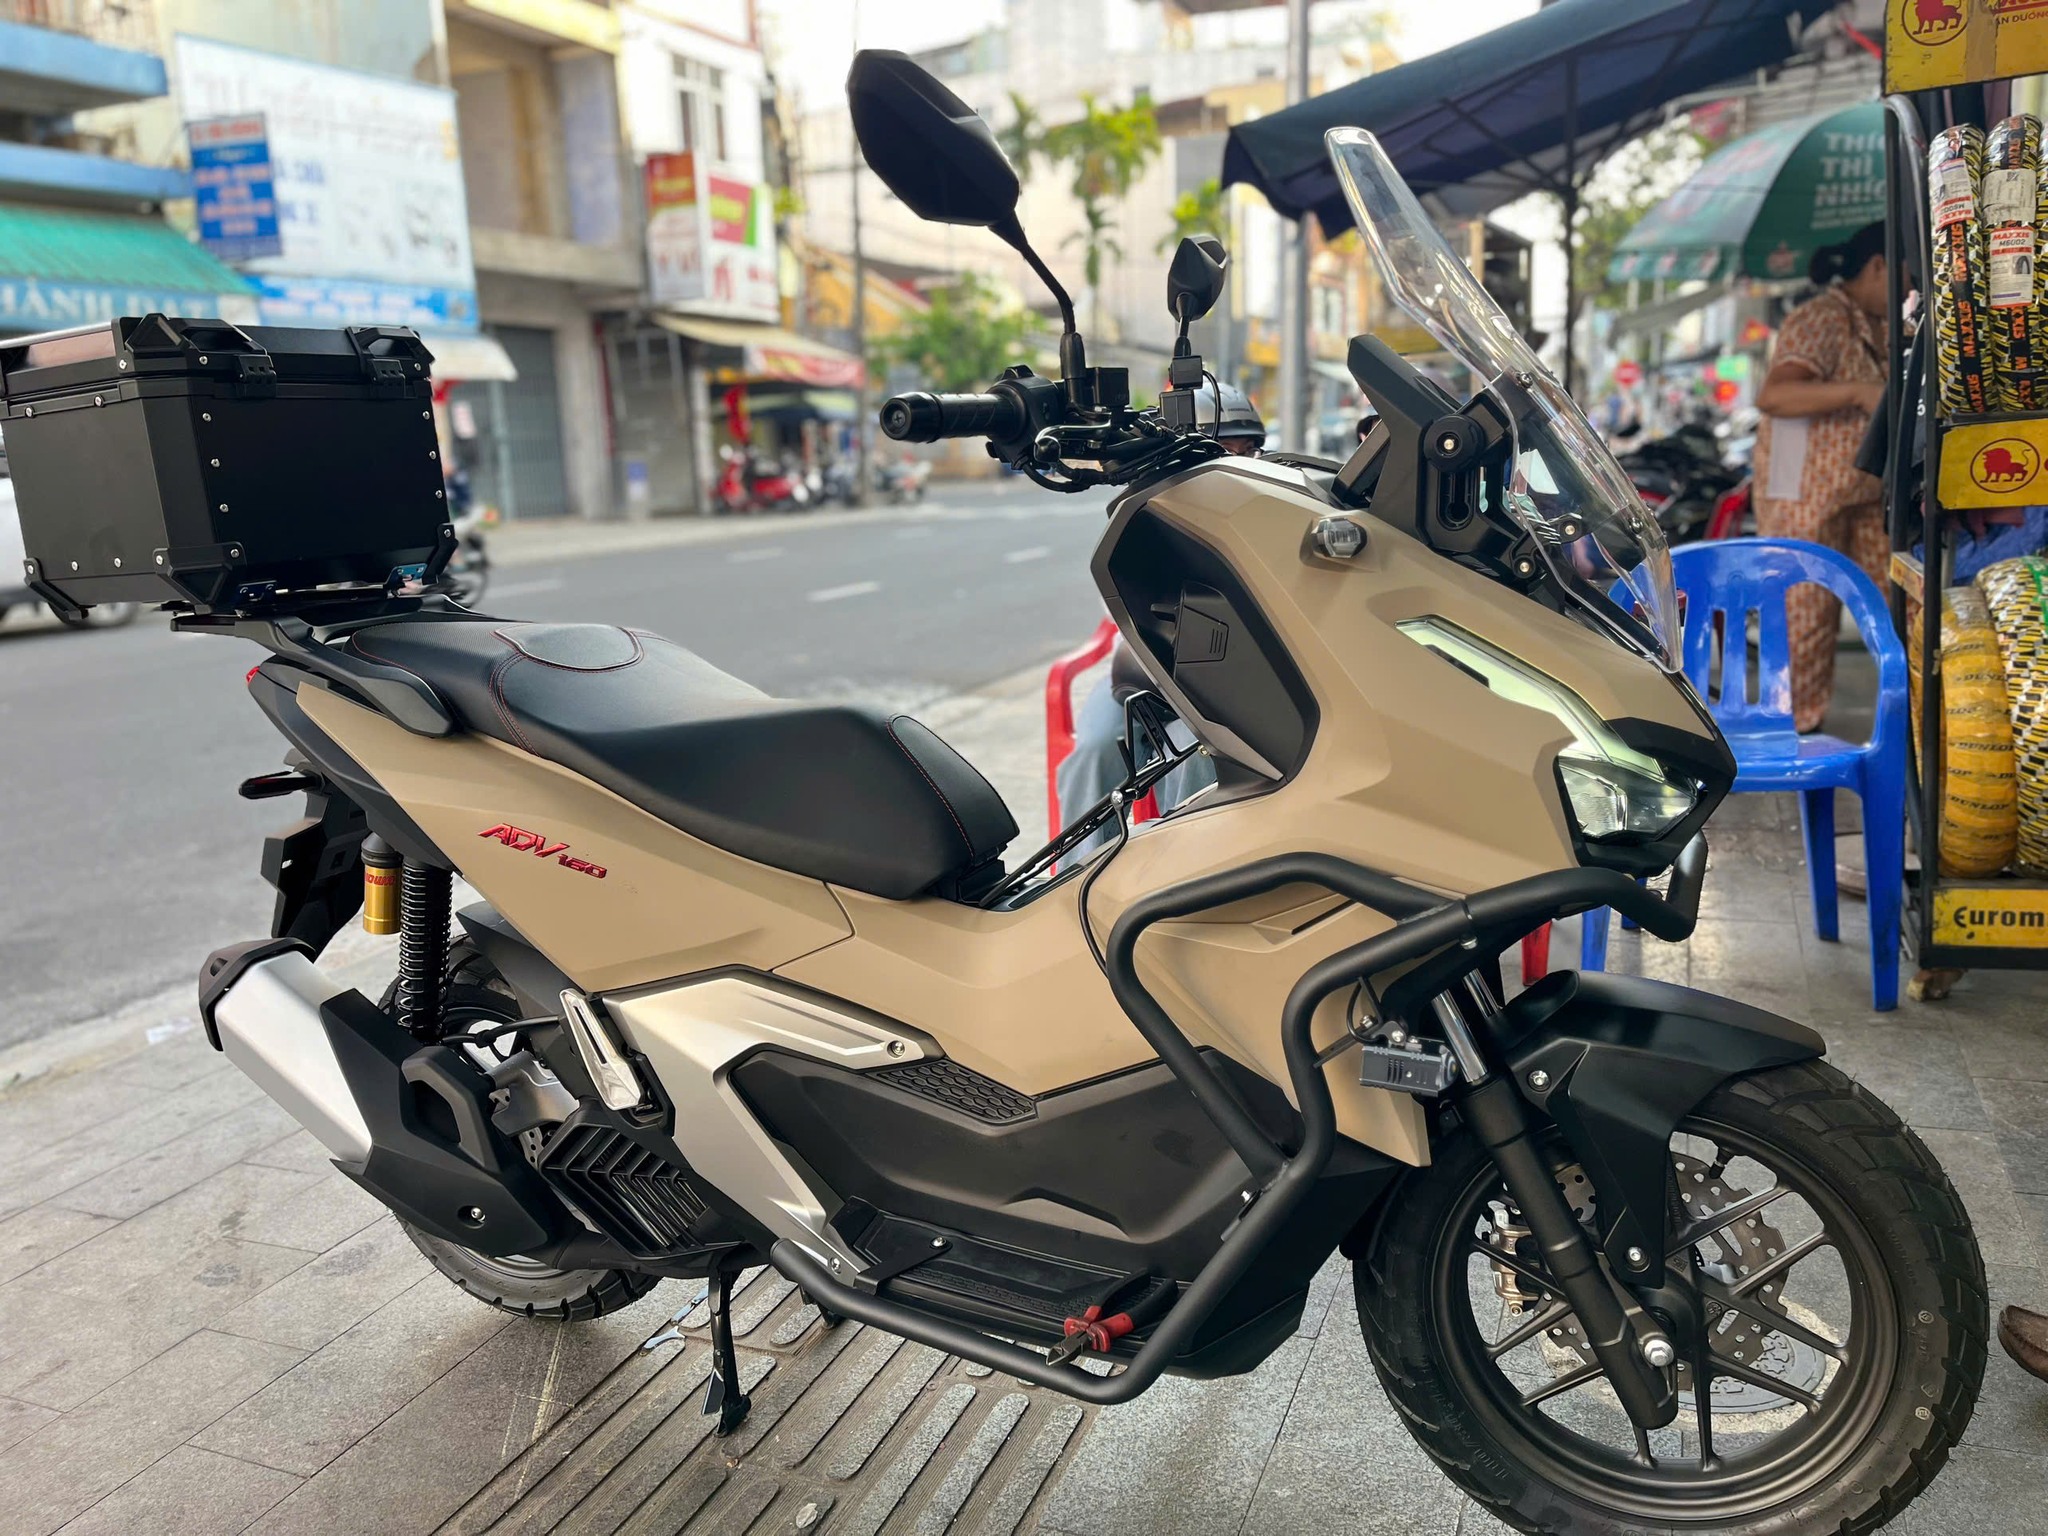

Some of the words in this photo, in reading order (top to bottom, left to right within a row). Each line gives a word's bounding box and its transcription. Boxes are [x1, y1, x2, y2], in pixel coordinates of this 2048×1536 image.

[1992, 231, 2030, 241] MAXXIS
[1957, 300, 1976, 357] MAXXIS
[1950, 795, 2010, 810] DUNLOP
[477, 823, 570, 858] ADV
